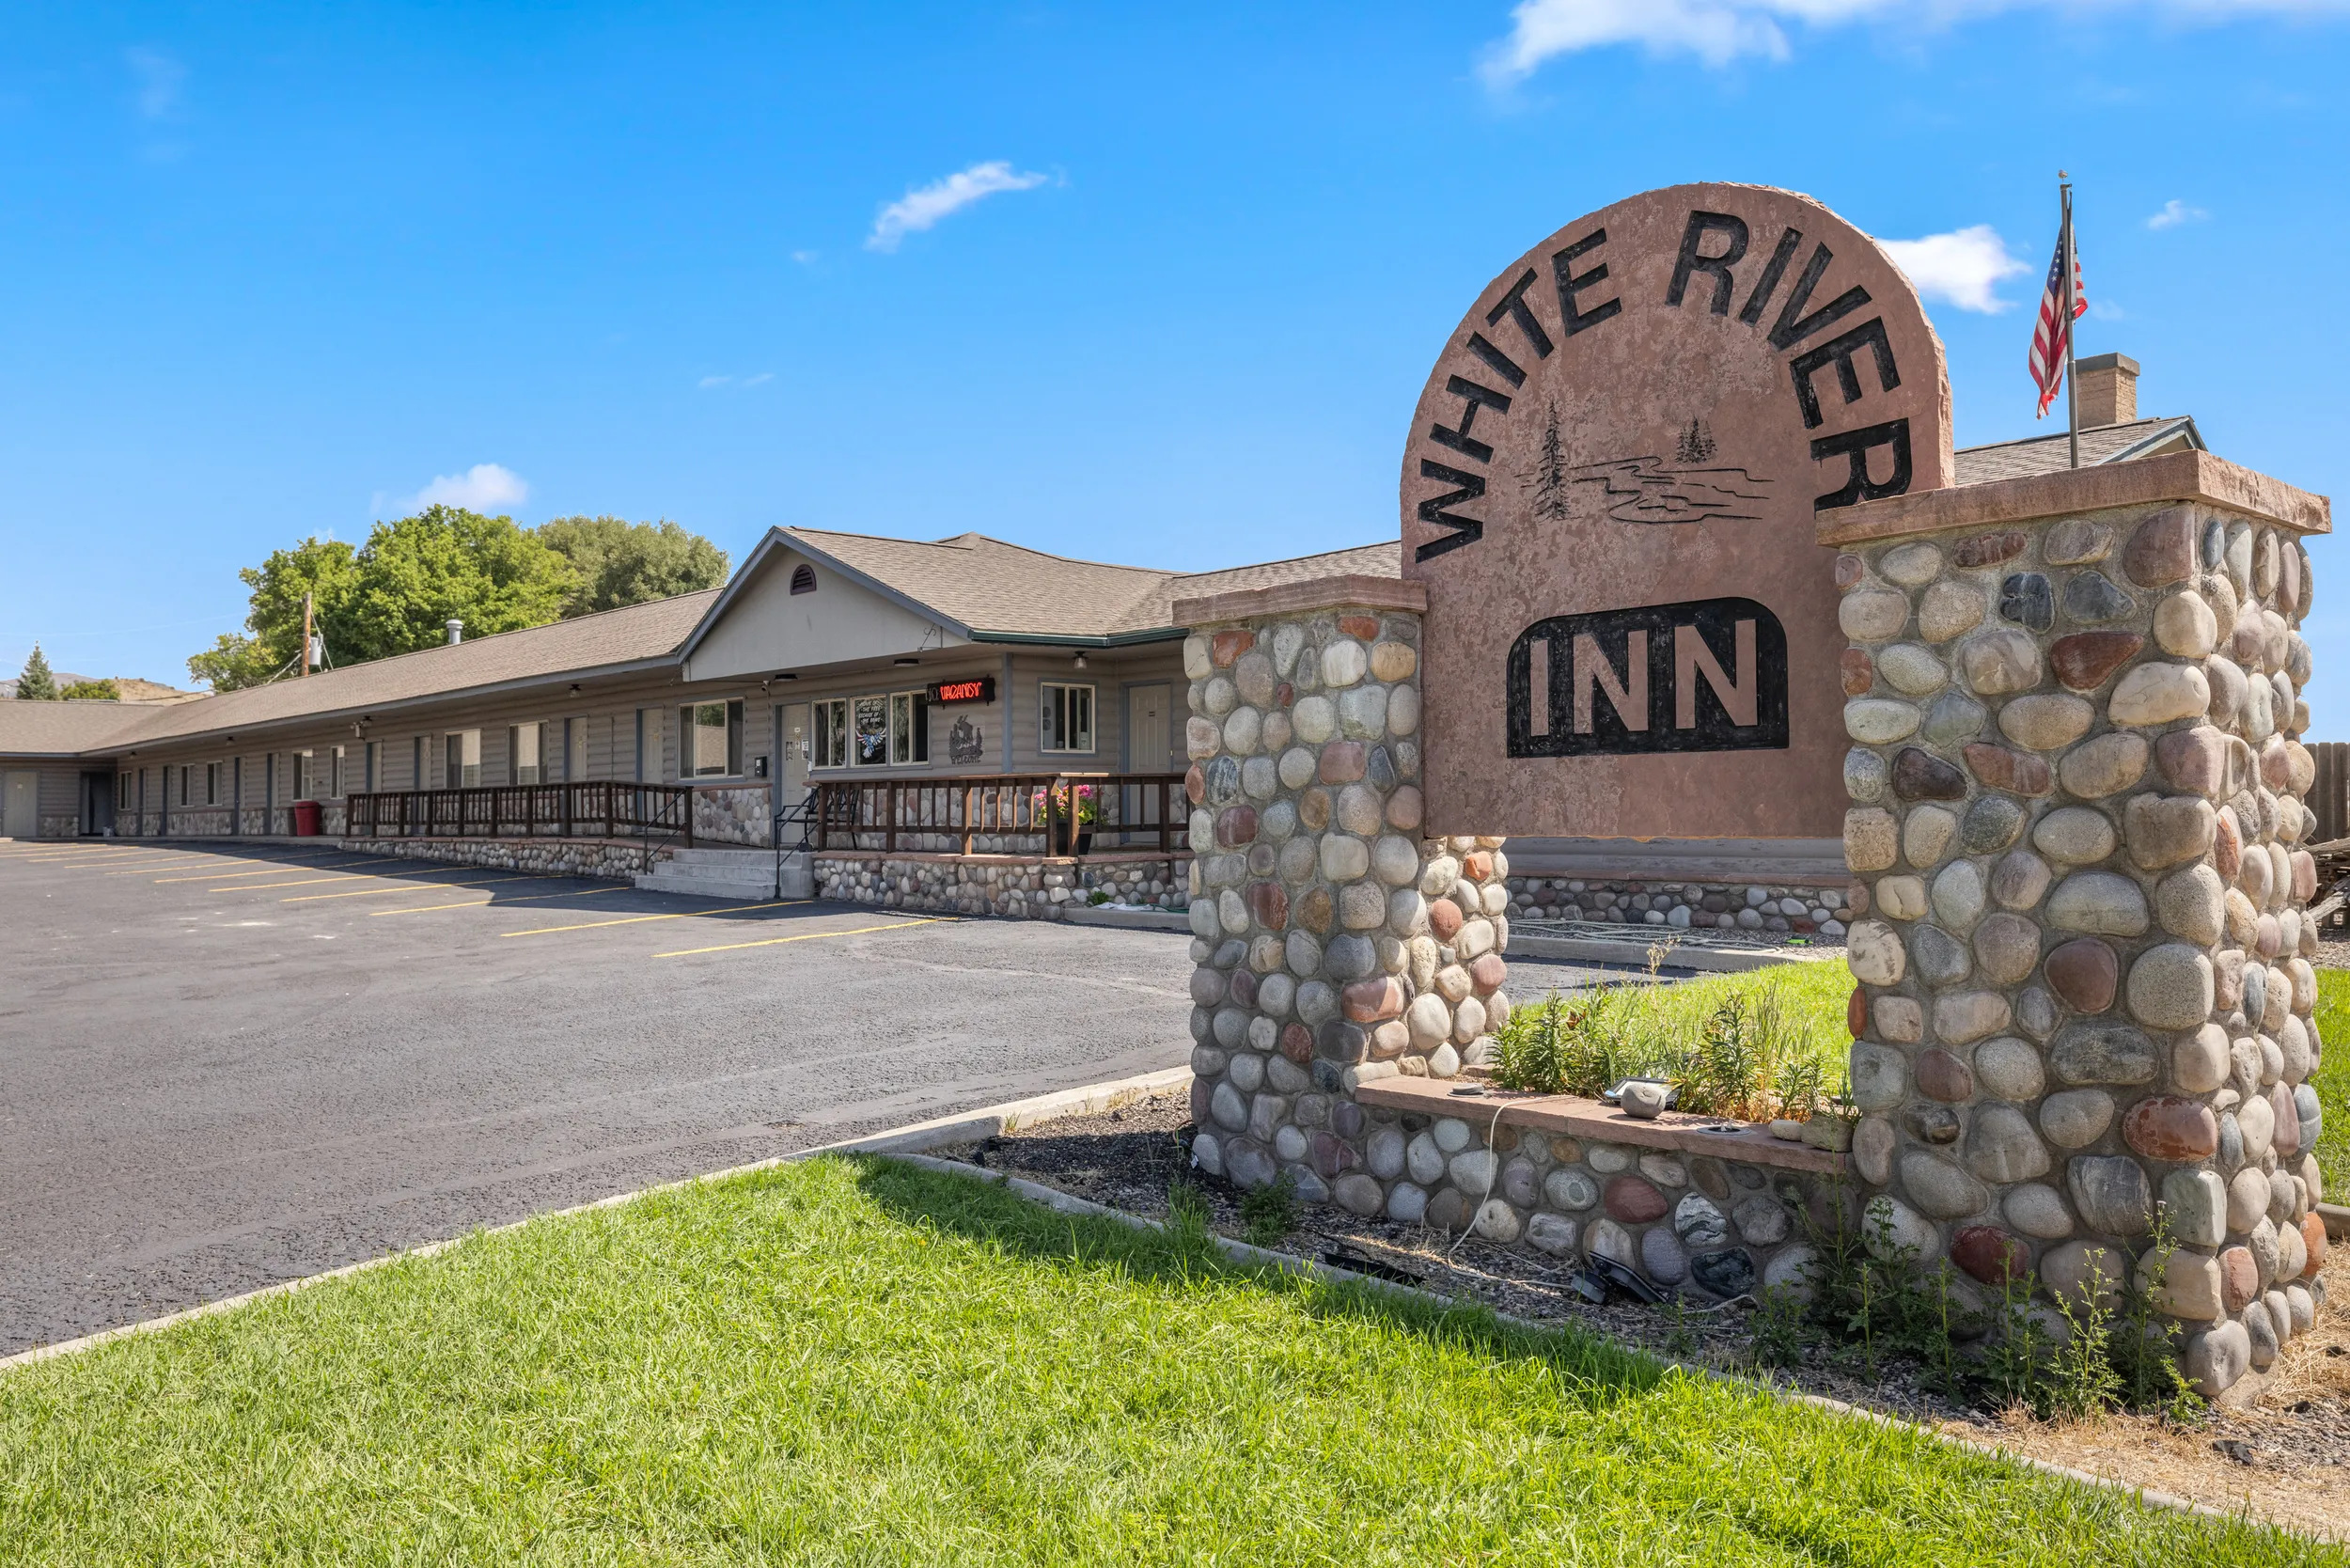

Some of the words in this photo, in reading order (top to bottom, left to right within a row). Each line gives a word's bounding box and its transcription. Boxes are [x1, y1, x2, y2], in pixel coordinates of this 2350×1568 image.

[1416, 227, 1622, 564] WHITE
[1666, 210, 1913, 517] RIVER
[940, 682, 982, 700] VACANCY
[1529, 619, 1758, 737] INN
[950, 755, 980, 764] WELCOME
